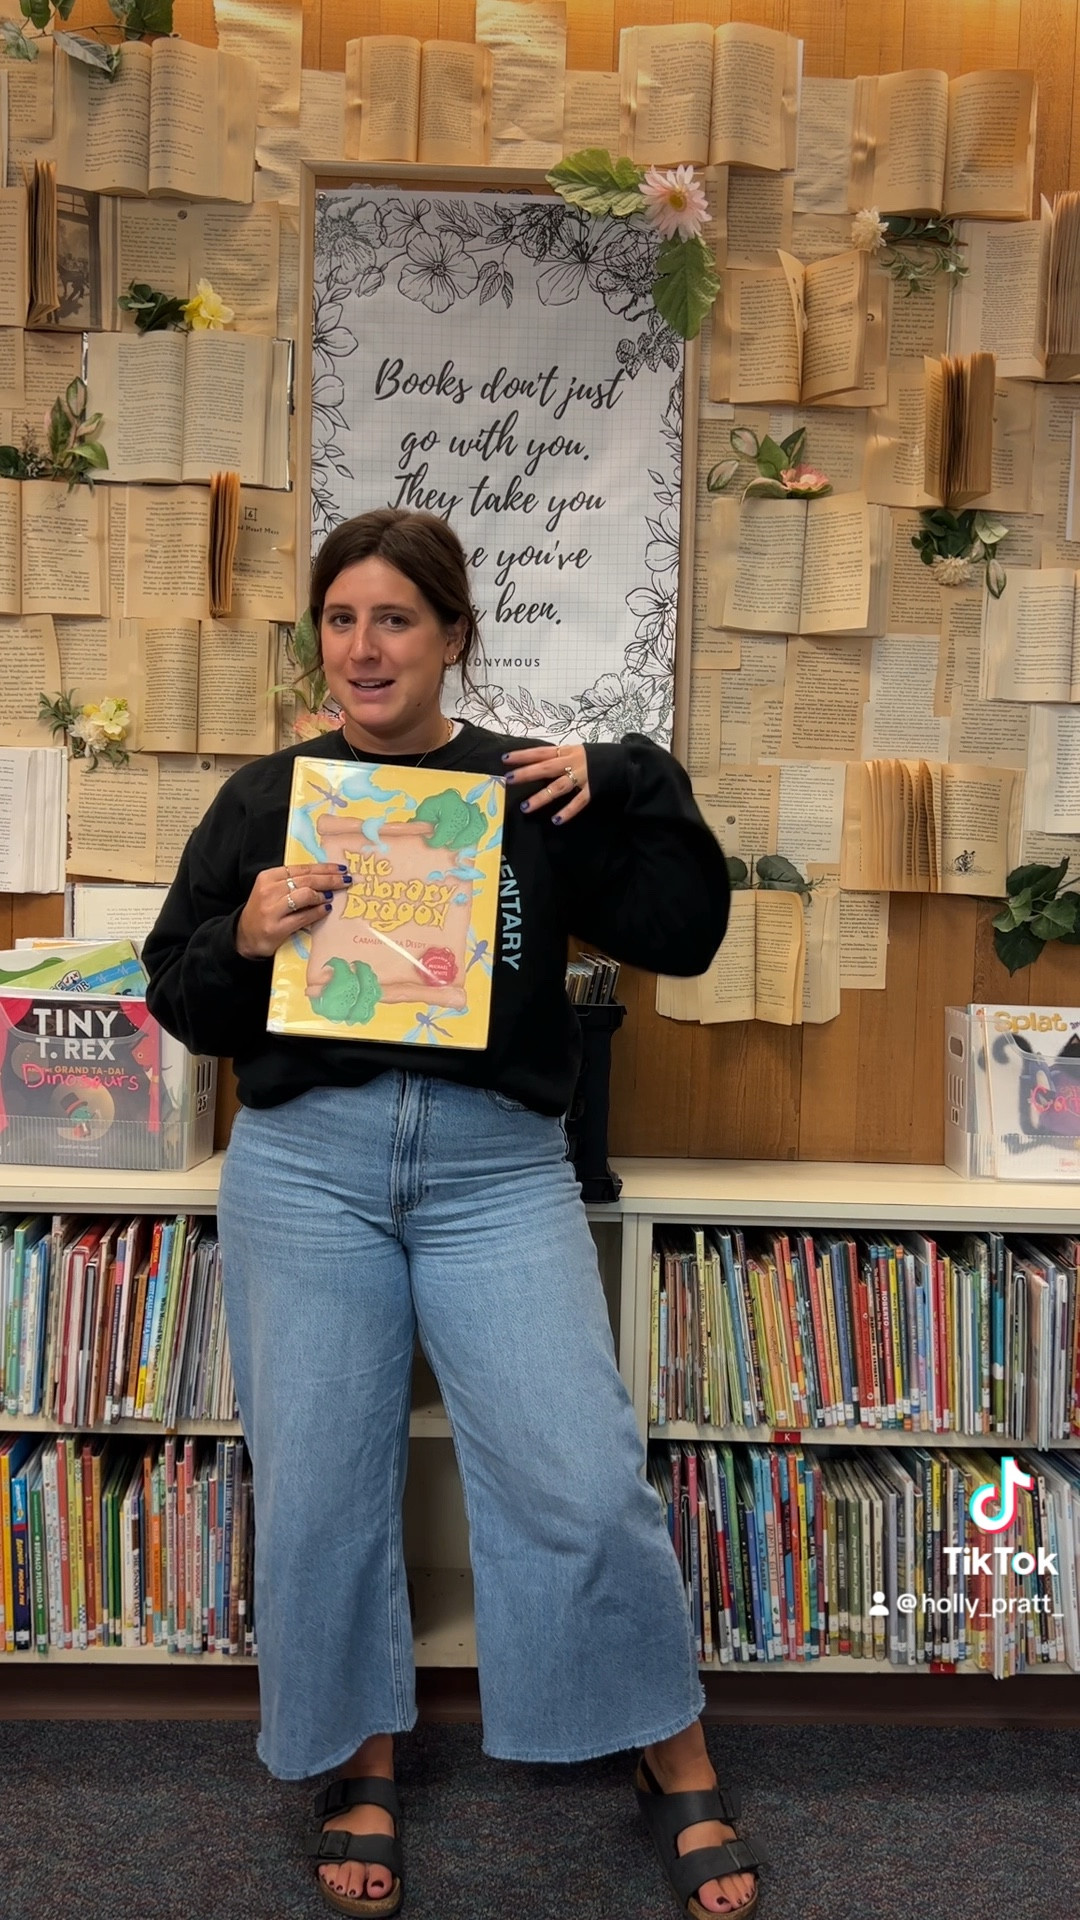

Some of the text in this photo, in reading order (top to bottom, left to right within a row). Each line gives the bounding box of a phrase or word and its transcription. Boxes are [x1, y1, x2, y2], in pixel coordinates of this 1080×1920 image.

[374, 357, 626, 420] Books don't just
[398, 410, 590, 476] go with you.
[388, 462, 606, 532] They take you
[495, 541, 592, 586] you've
[495, 581, 562, 625] been.
[466, 659, 540, 668] ONYMOUS
[33, 1008, 118, 1038] TINY
[993, 1011, 1067, 1033] Splat
[35, 1038, 115, 1060] T. REX
[22, 1063, 139, 1091] Dinosaurs
[54, 1065, 89, 1074] GRAND
[881, 1290, 889, 1327] ROBERTO
[157, 1312, 165, 1334] Moved
[155, 1335, 163, 1344] My
[152, 1345, 162, 1371] Cheese?
[784, 1433, 790, 1442] K
[926, 1533, 932, 1543] NO
[34, 1542, 43, 1603] BUFFALO FLUFFALO
[839, 1560, 844, 1568] AT
